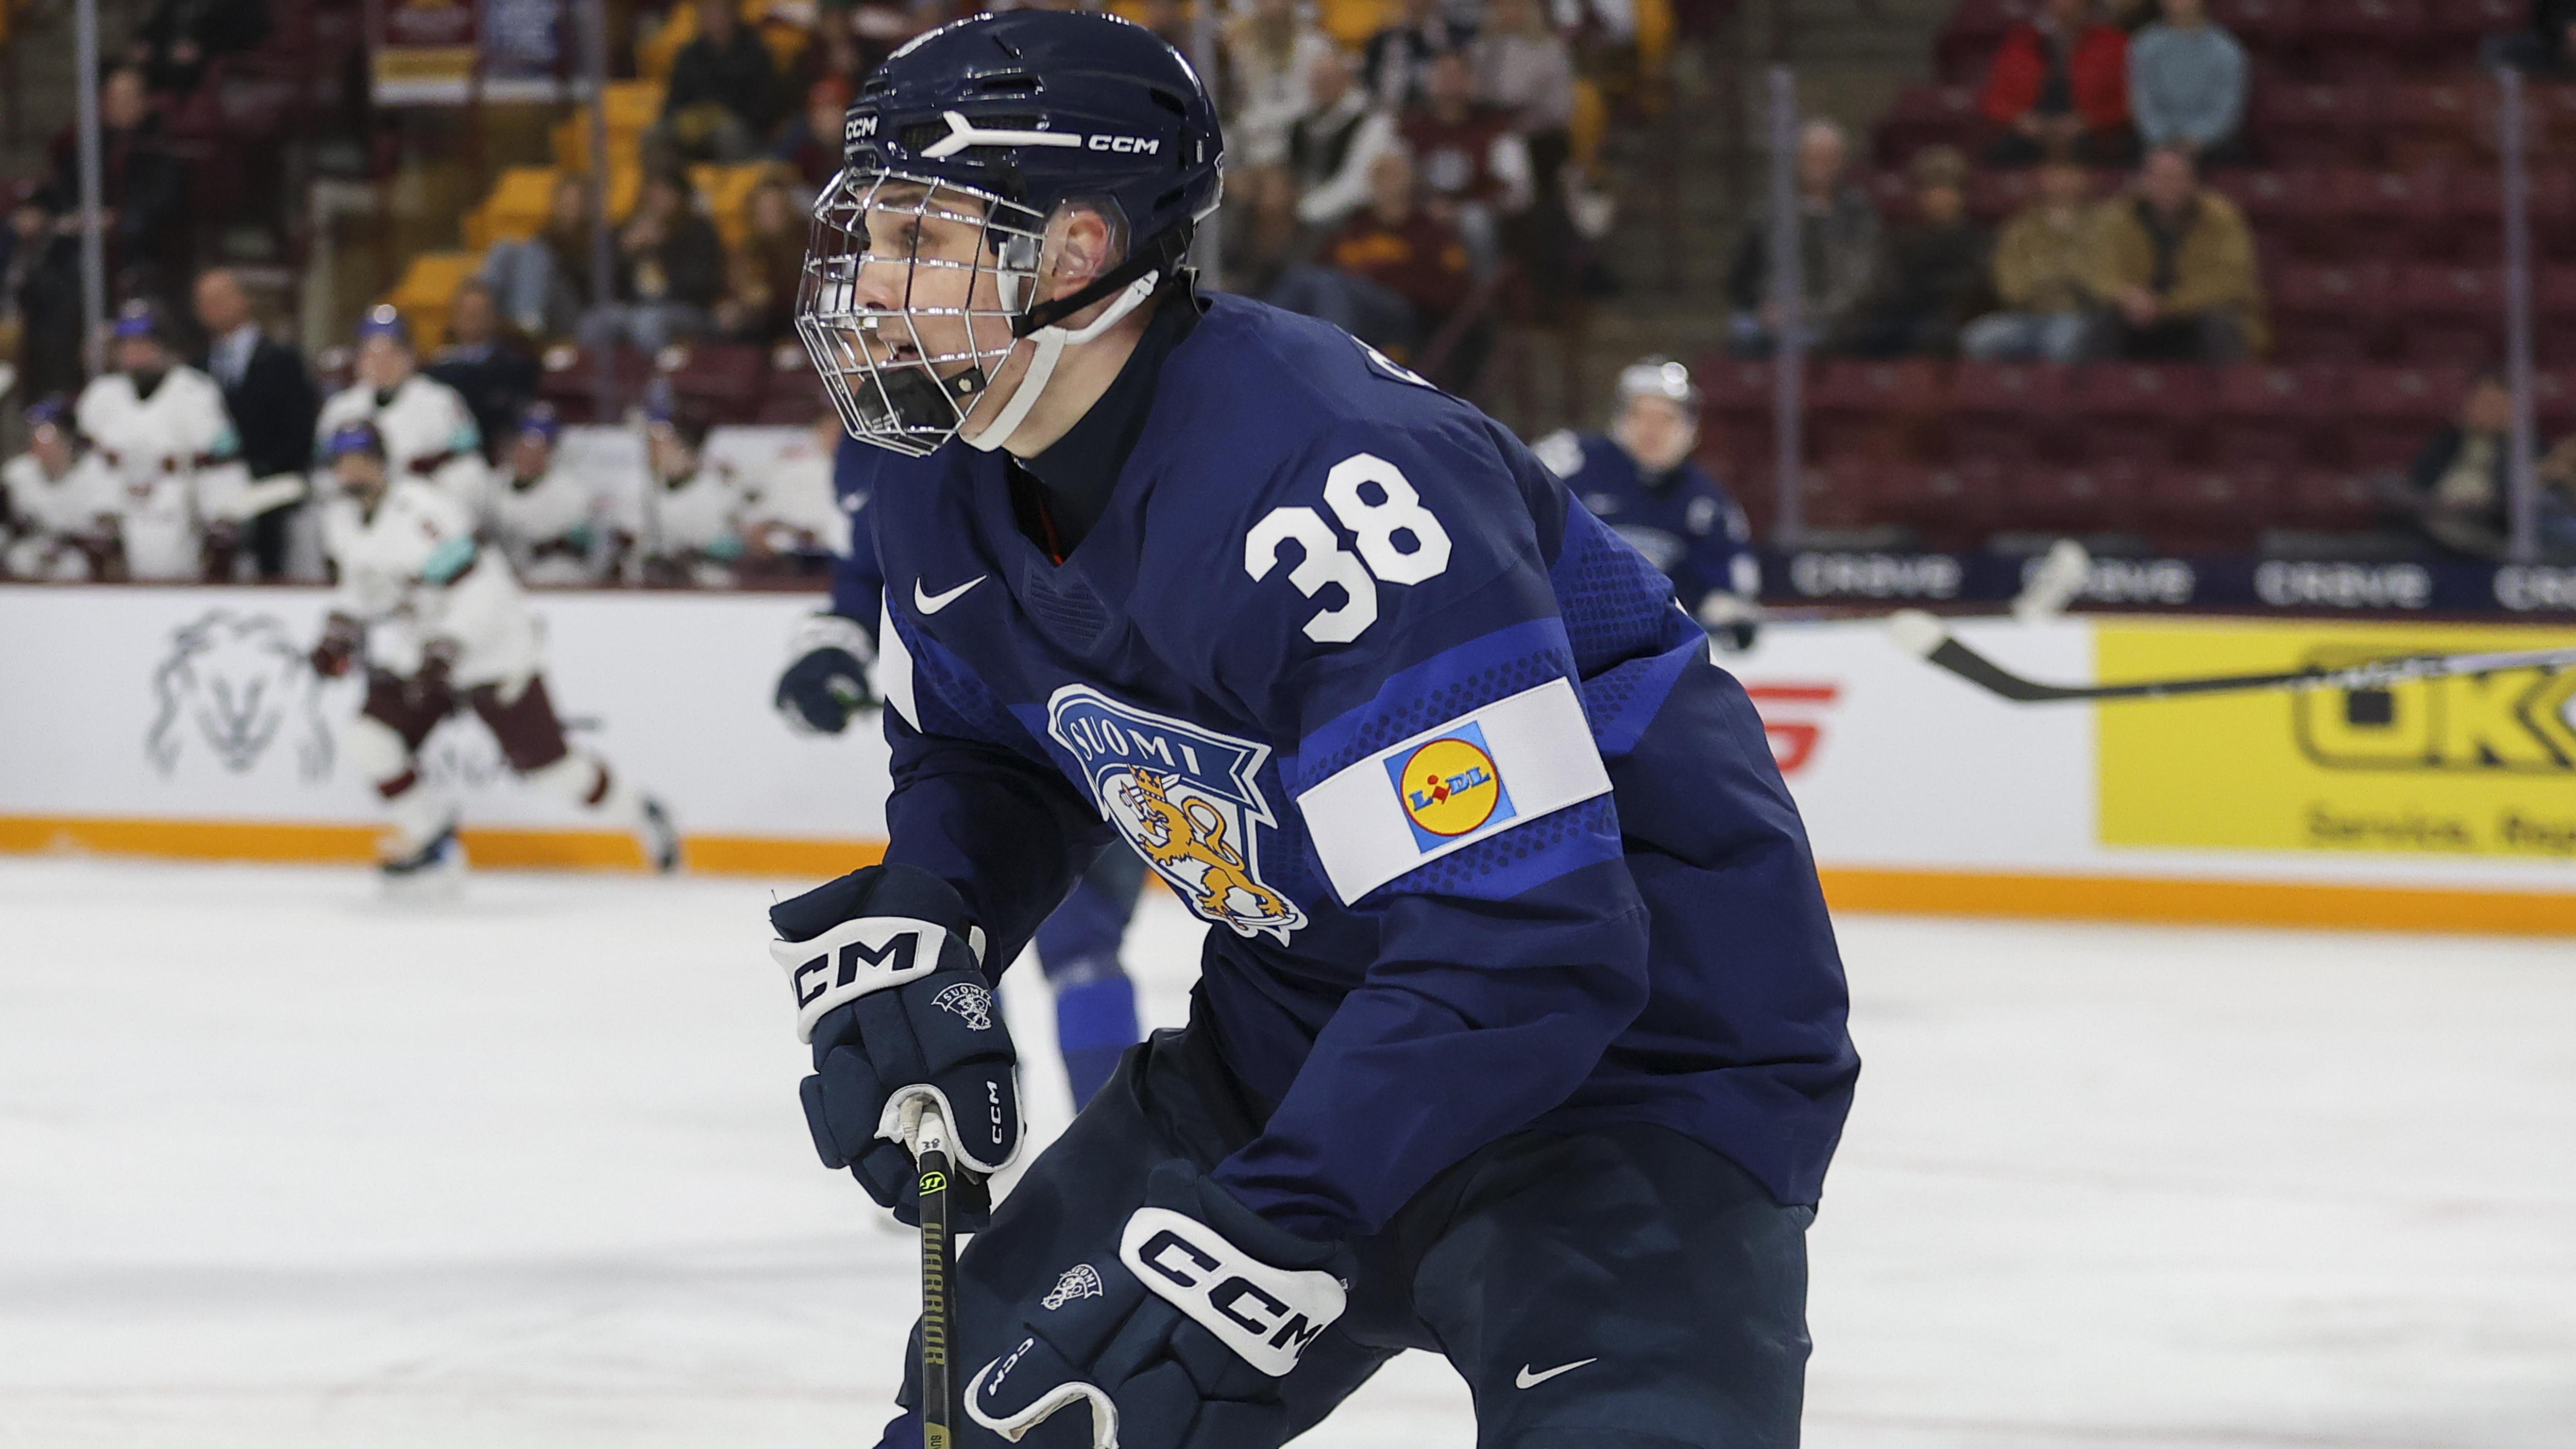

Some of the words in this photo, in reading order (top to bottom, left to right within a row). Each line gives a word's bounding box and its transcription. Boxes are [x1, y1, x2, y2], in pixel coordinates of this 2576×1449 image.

[845, 115, 878, 140] CCM
[1088, 134, 1159, 155] CCM
[1244, 452, 1452, 643] 38
[1070, 716, 1201, 776] SUOMI
[986, 1081, 1002, 1144] CCM
[921, 1138, 940, 1151] 38
[922, 1222, 945, 1366] WARRIOR
[1139, 1229, 1324, 1359] CCM
[988, 1338, 1034, 1396] CCM
